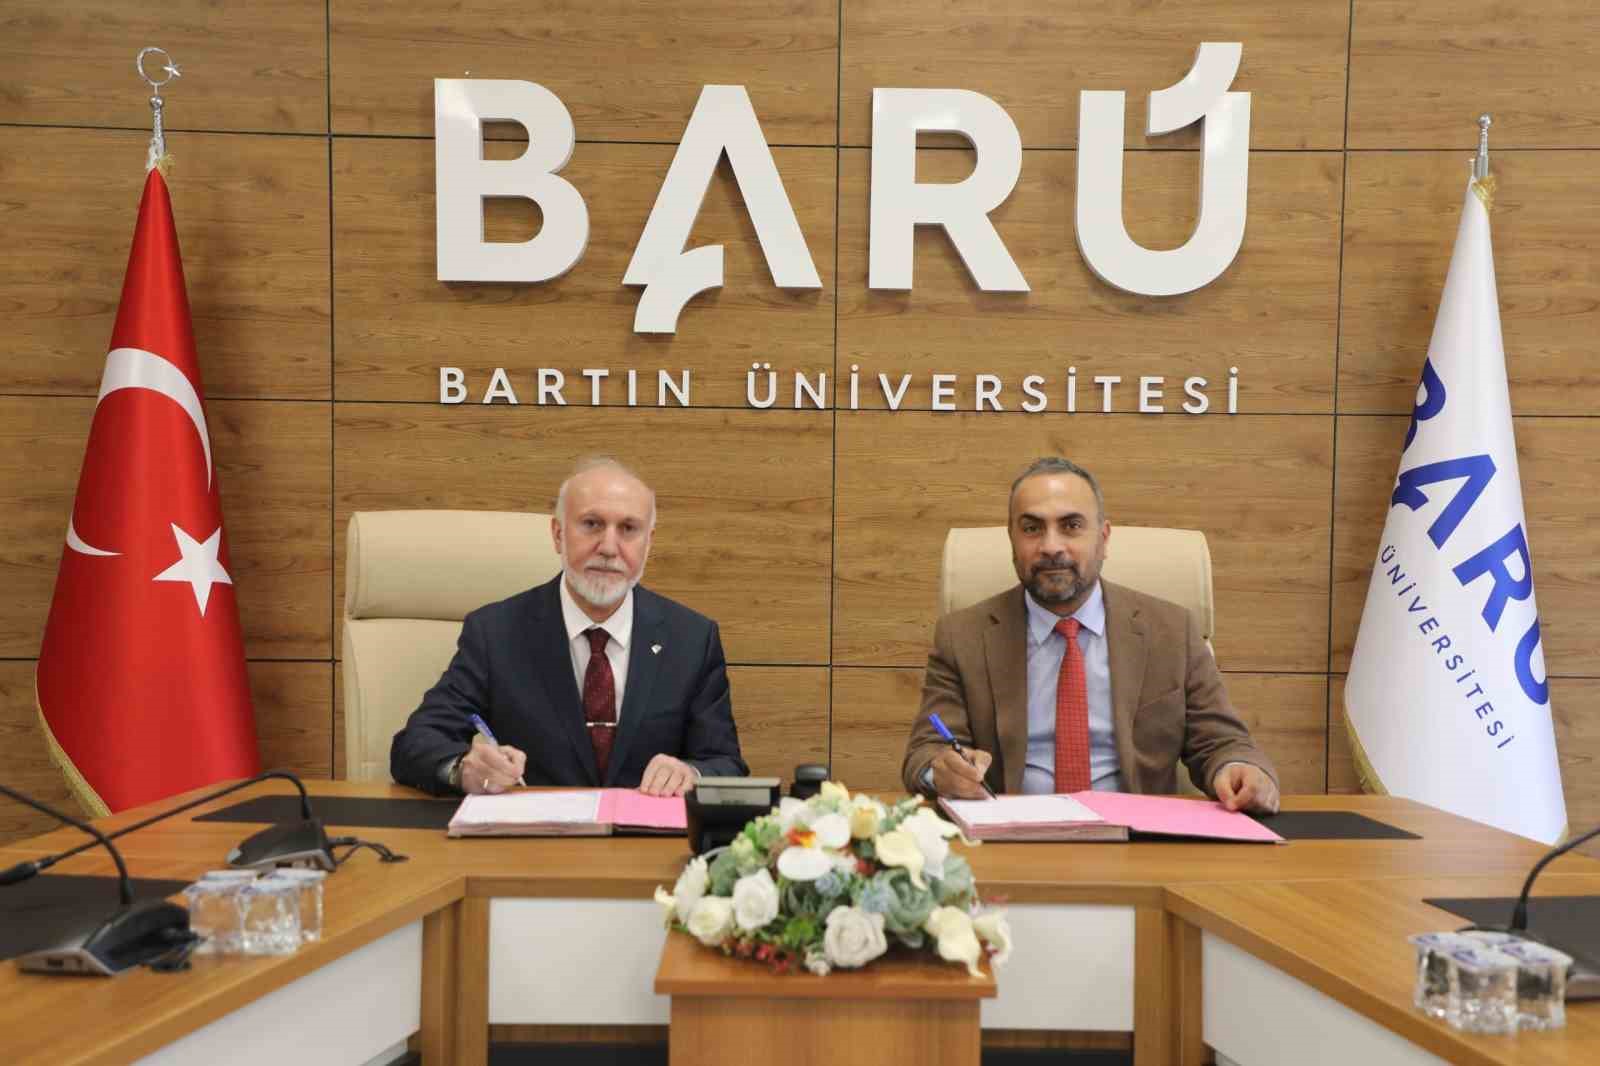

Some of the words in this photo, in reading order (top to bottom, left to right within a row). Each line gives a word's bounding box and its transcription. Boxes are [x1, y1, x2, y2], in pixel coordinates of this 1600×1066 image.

[439, 367, 691, 406] BARTIN
[746, 363, 1240, 413] ÜNİVERSİTESİ
[1380, 545, 1515, 749] ÜNİVERSİTESİ
